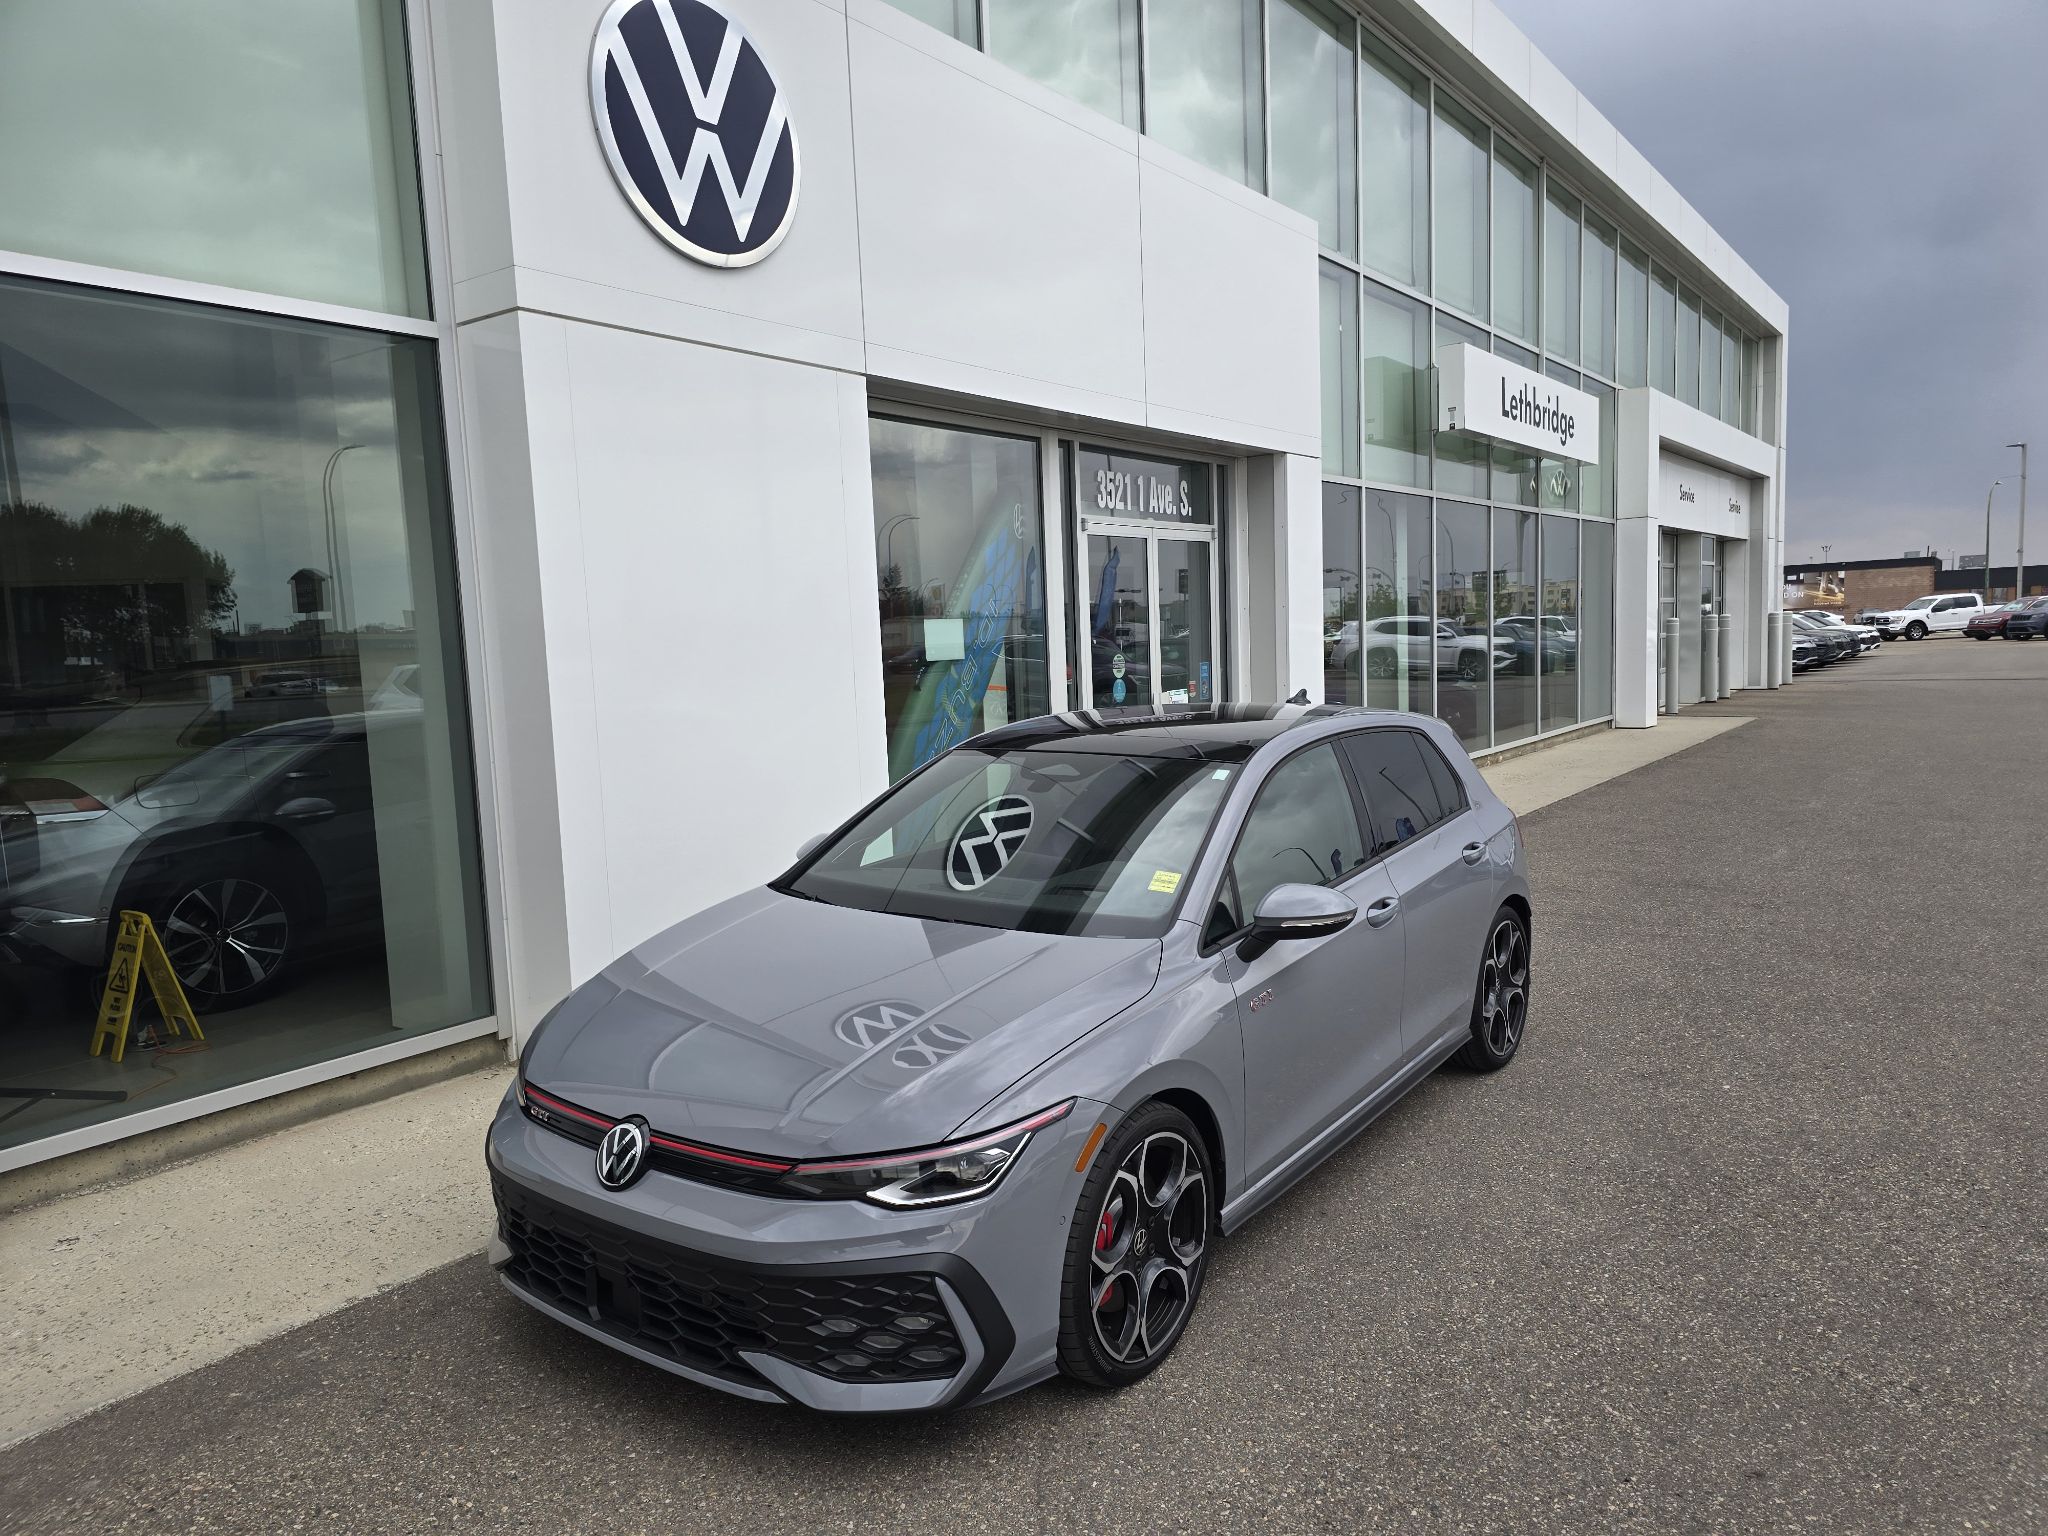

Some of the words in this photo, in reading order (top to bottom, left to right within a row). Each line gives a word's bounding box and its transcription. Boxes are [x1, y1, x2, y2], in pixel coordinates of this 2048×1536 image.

[592, 0, 799, 260] VW
[1501, 376, 1575, 446] Lethbridge
[1097, 469, 1132, 511] 3521
[1137, 475, 1144, 512] 1
[1149, 476, 1177, 515] Ave.
[1180, 480, 1192, 517] S.
[1680, 484, 1695, 503] Service
[1729, 497, 1741, 514] Service
[530, 1105, 550, 1121] GTI
[597, 1122, 643, 1187] VW
